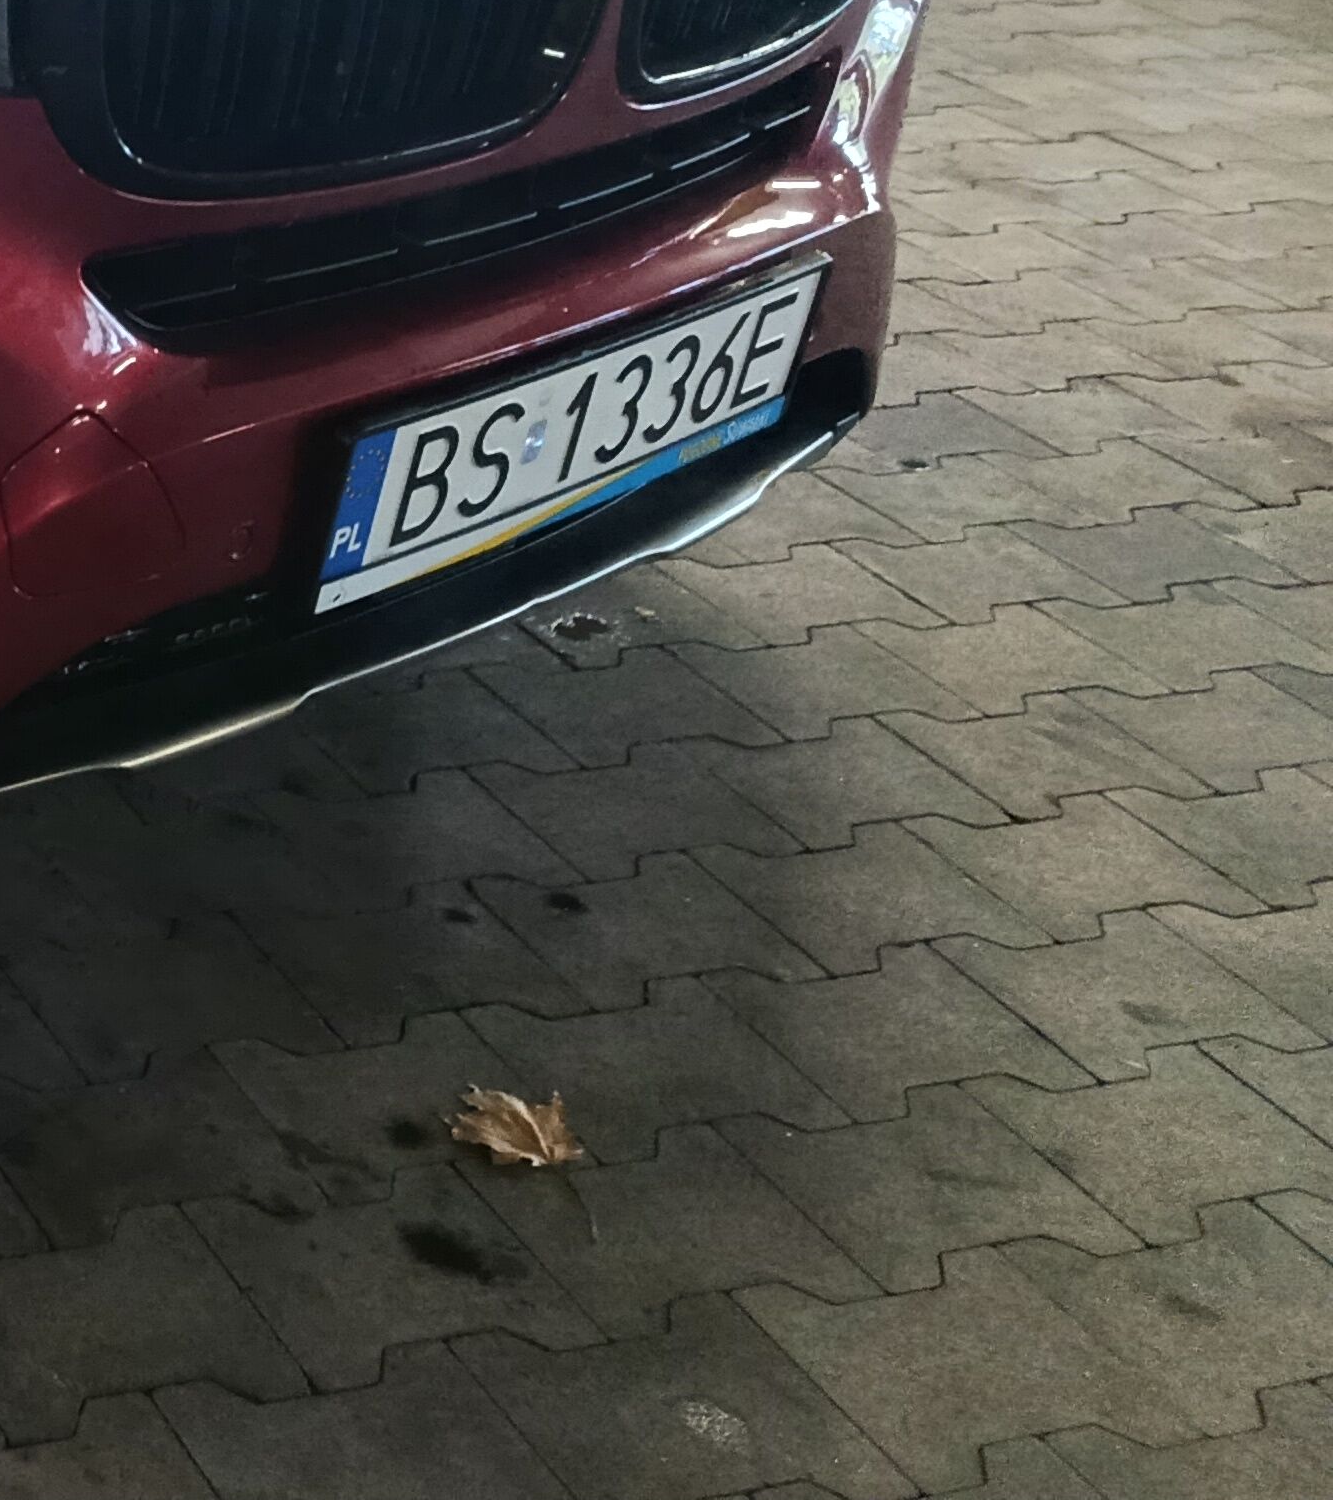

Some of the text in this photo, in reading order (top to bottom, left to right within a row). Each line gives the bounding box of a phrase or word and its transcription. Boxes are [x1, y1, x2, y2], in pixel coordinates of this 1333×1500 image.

[389, 291, 800, 548] BS 1336E
[329, 521, 361, 560] PL
